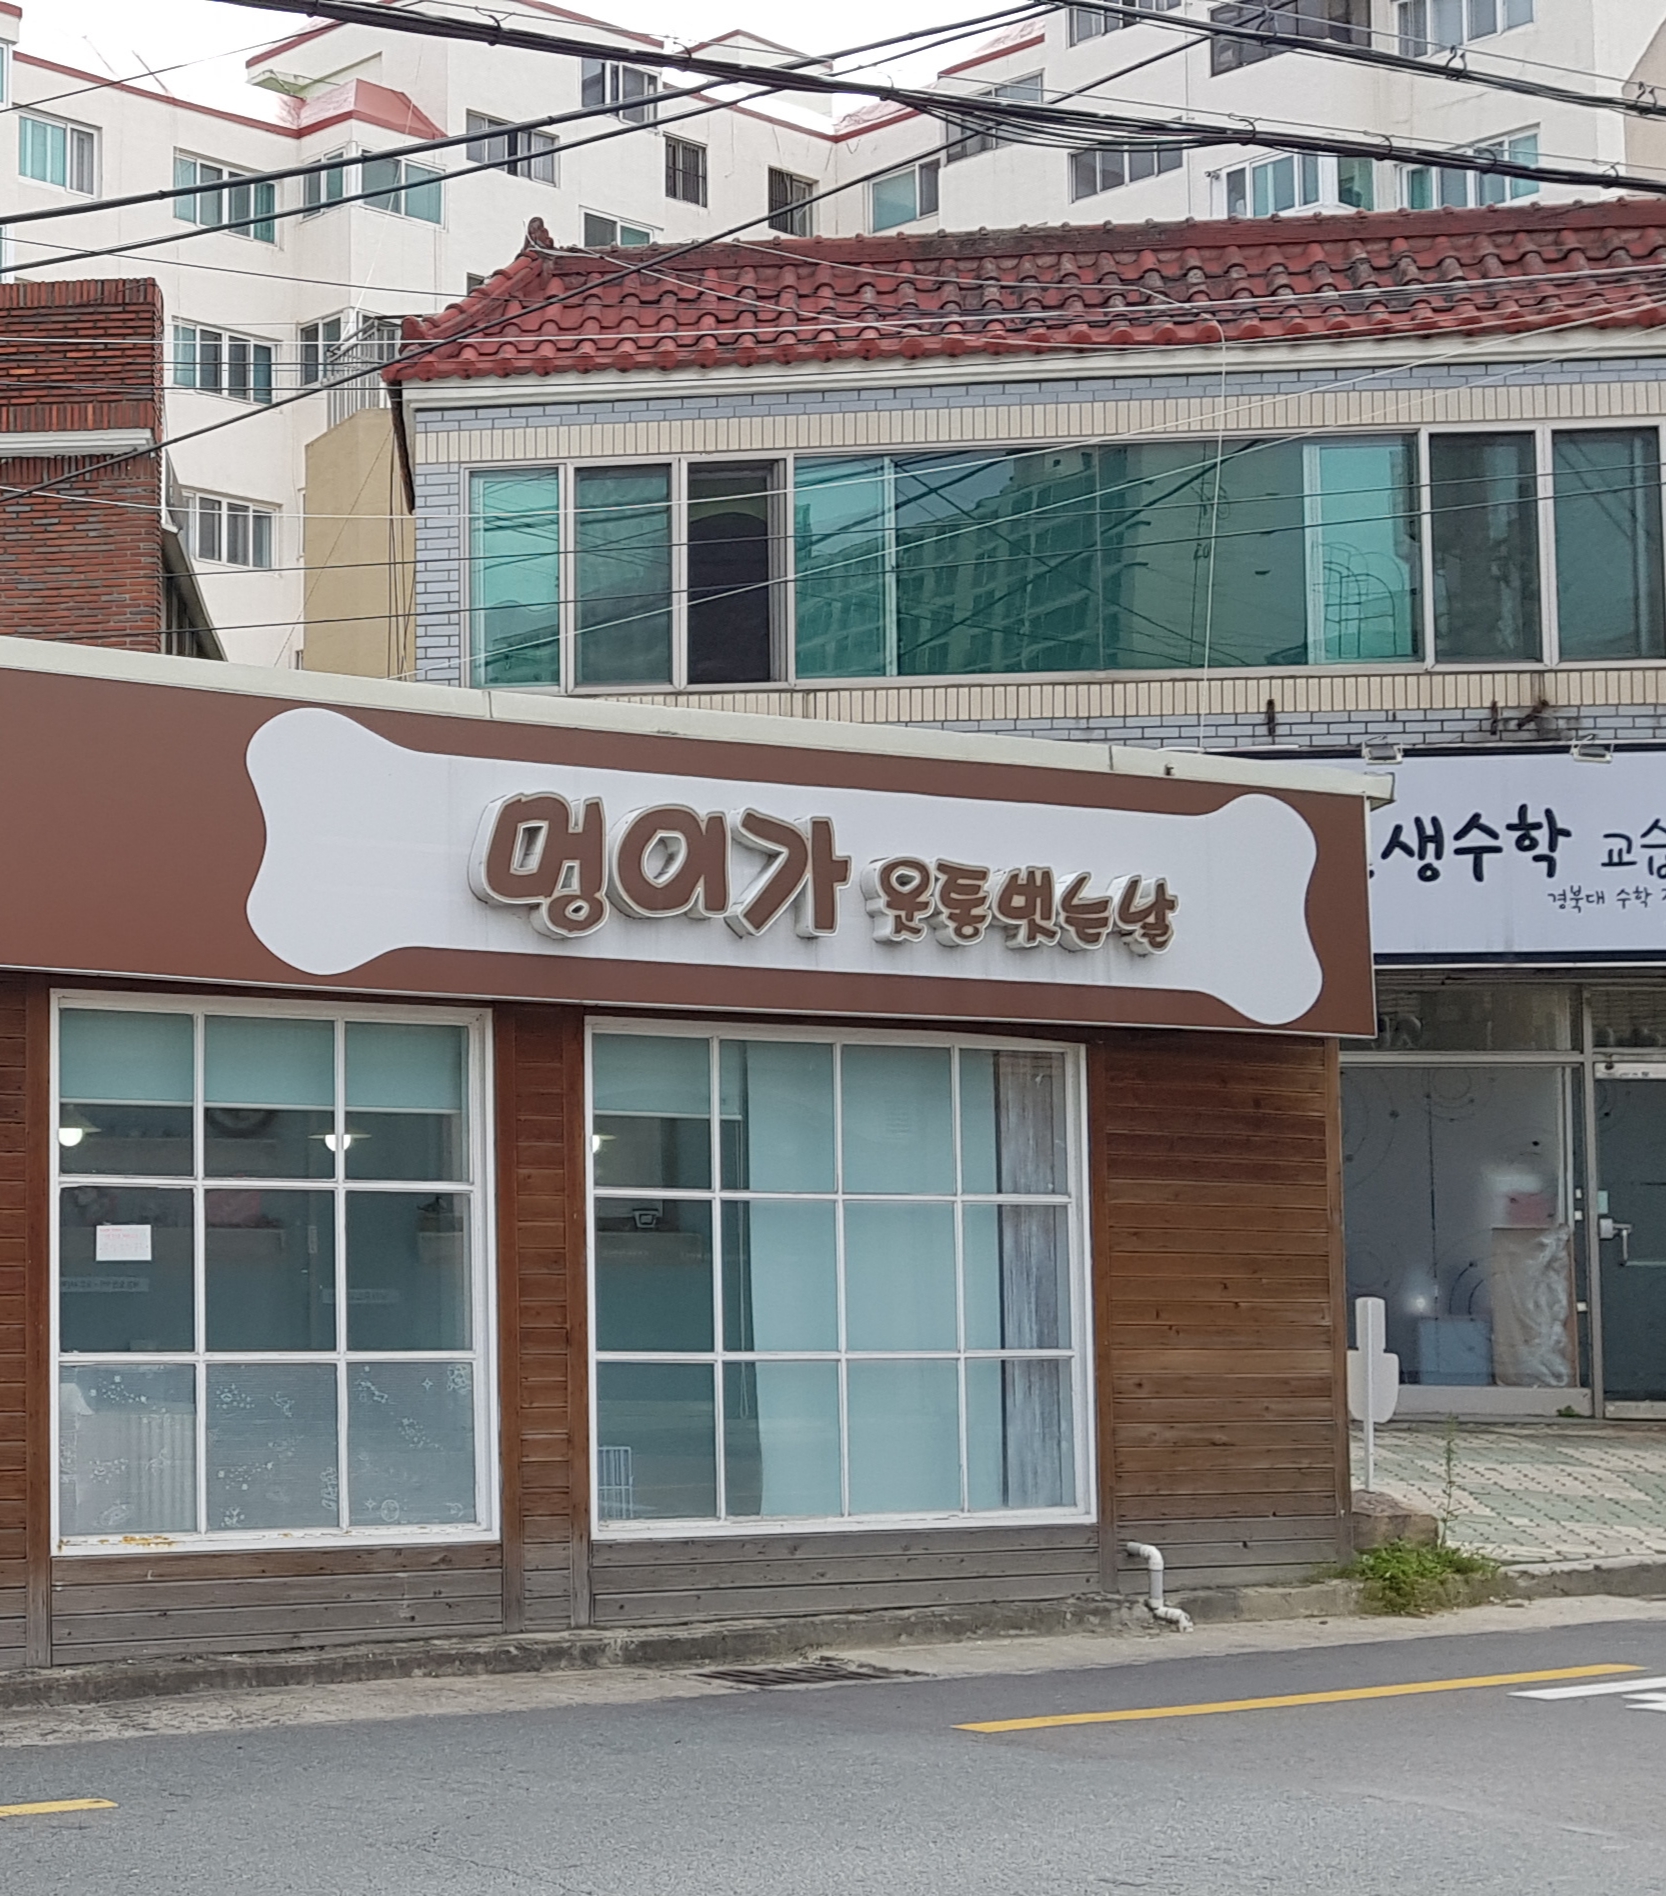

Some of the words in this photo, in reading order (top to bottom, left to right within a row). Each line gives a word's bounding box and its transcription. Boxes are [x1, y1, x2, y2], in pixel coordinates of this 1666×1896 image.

[476, 790, 852, 938] 멍이가
[1369, 804, 1572, 883] 생수학
[1547, 885, 1605, 913] 경북대
[1616, 885, 1653, 909] 수학
